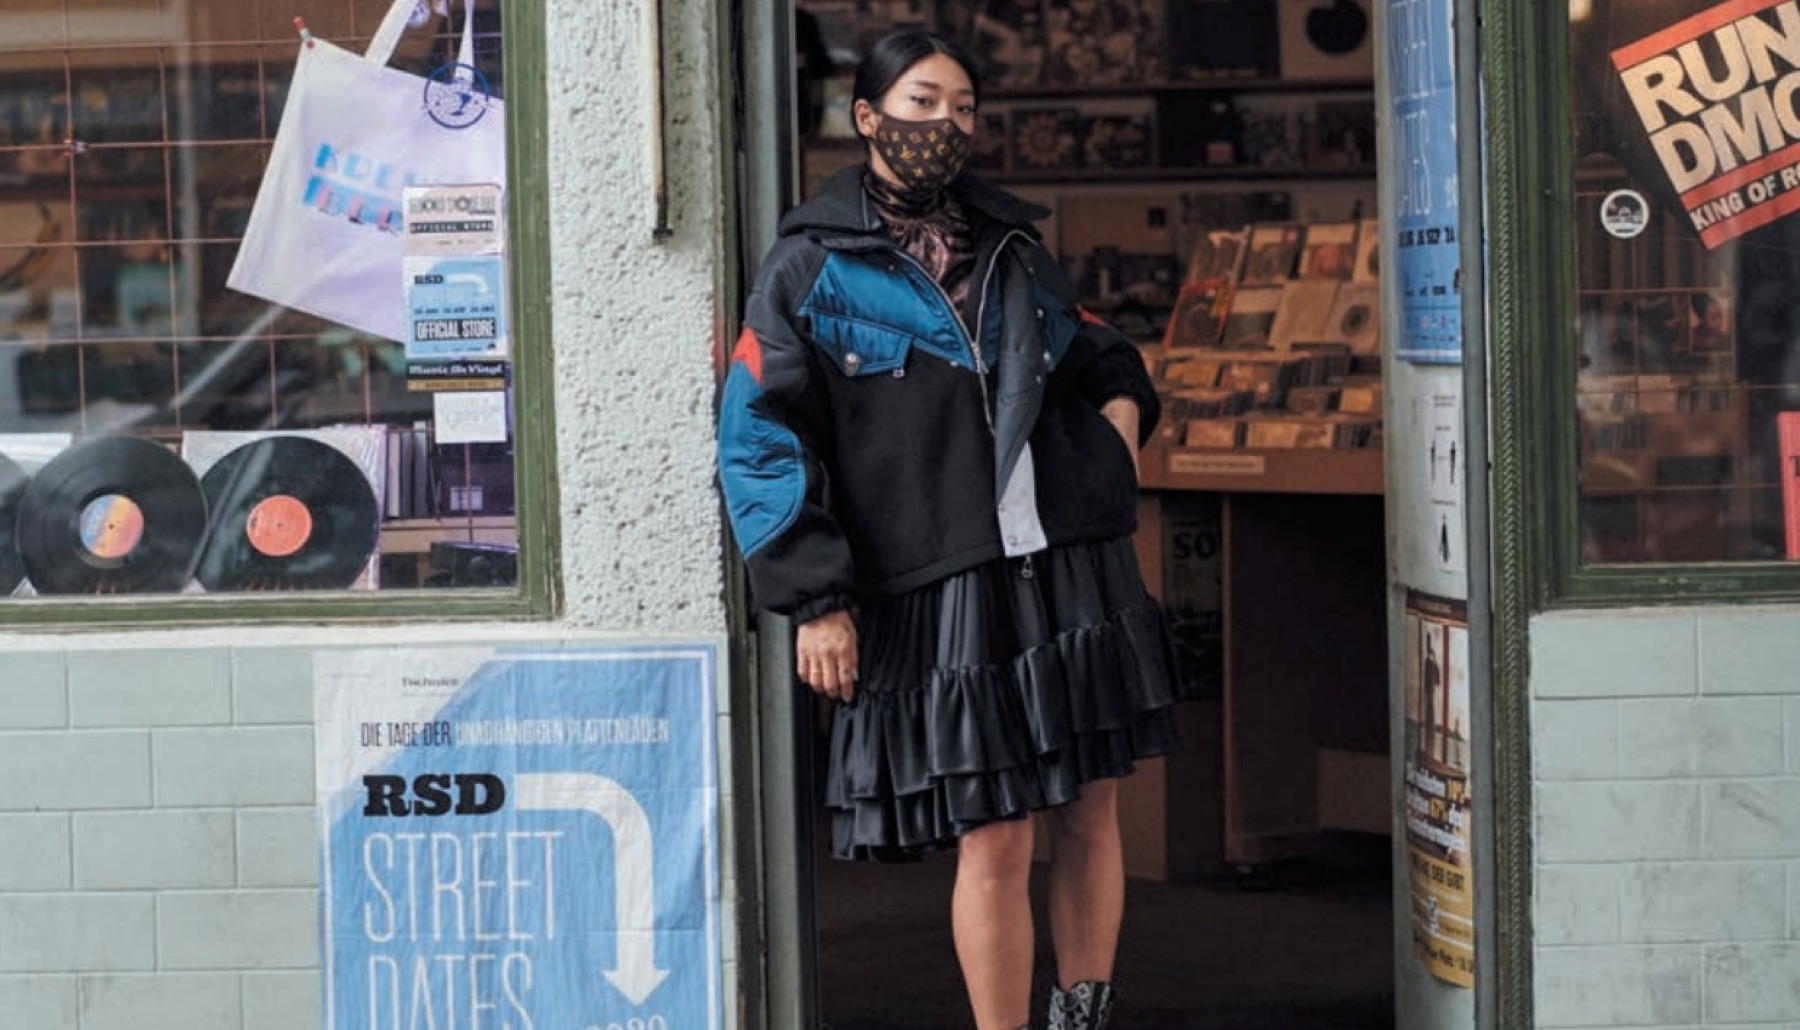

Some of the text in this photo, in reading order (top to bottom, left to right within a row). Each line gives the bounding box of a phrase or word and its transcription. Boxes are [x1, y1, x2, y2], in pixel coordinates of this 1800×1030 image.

[1620, 1, 1800, 134] RUN
[1690, 163, 1800, 231] KING OF R
[417, 319, 495, 339] OFFICIAL STORE
[361, 722, 382, 747] DIE
[386, 722, 419, 747] TAGE
[423, 720, 452, 747] DER
[363, 773, 506, 817] RSD
[363, 831, 565, 943] STREET
[368, 952, 535, 1030] DATES
